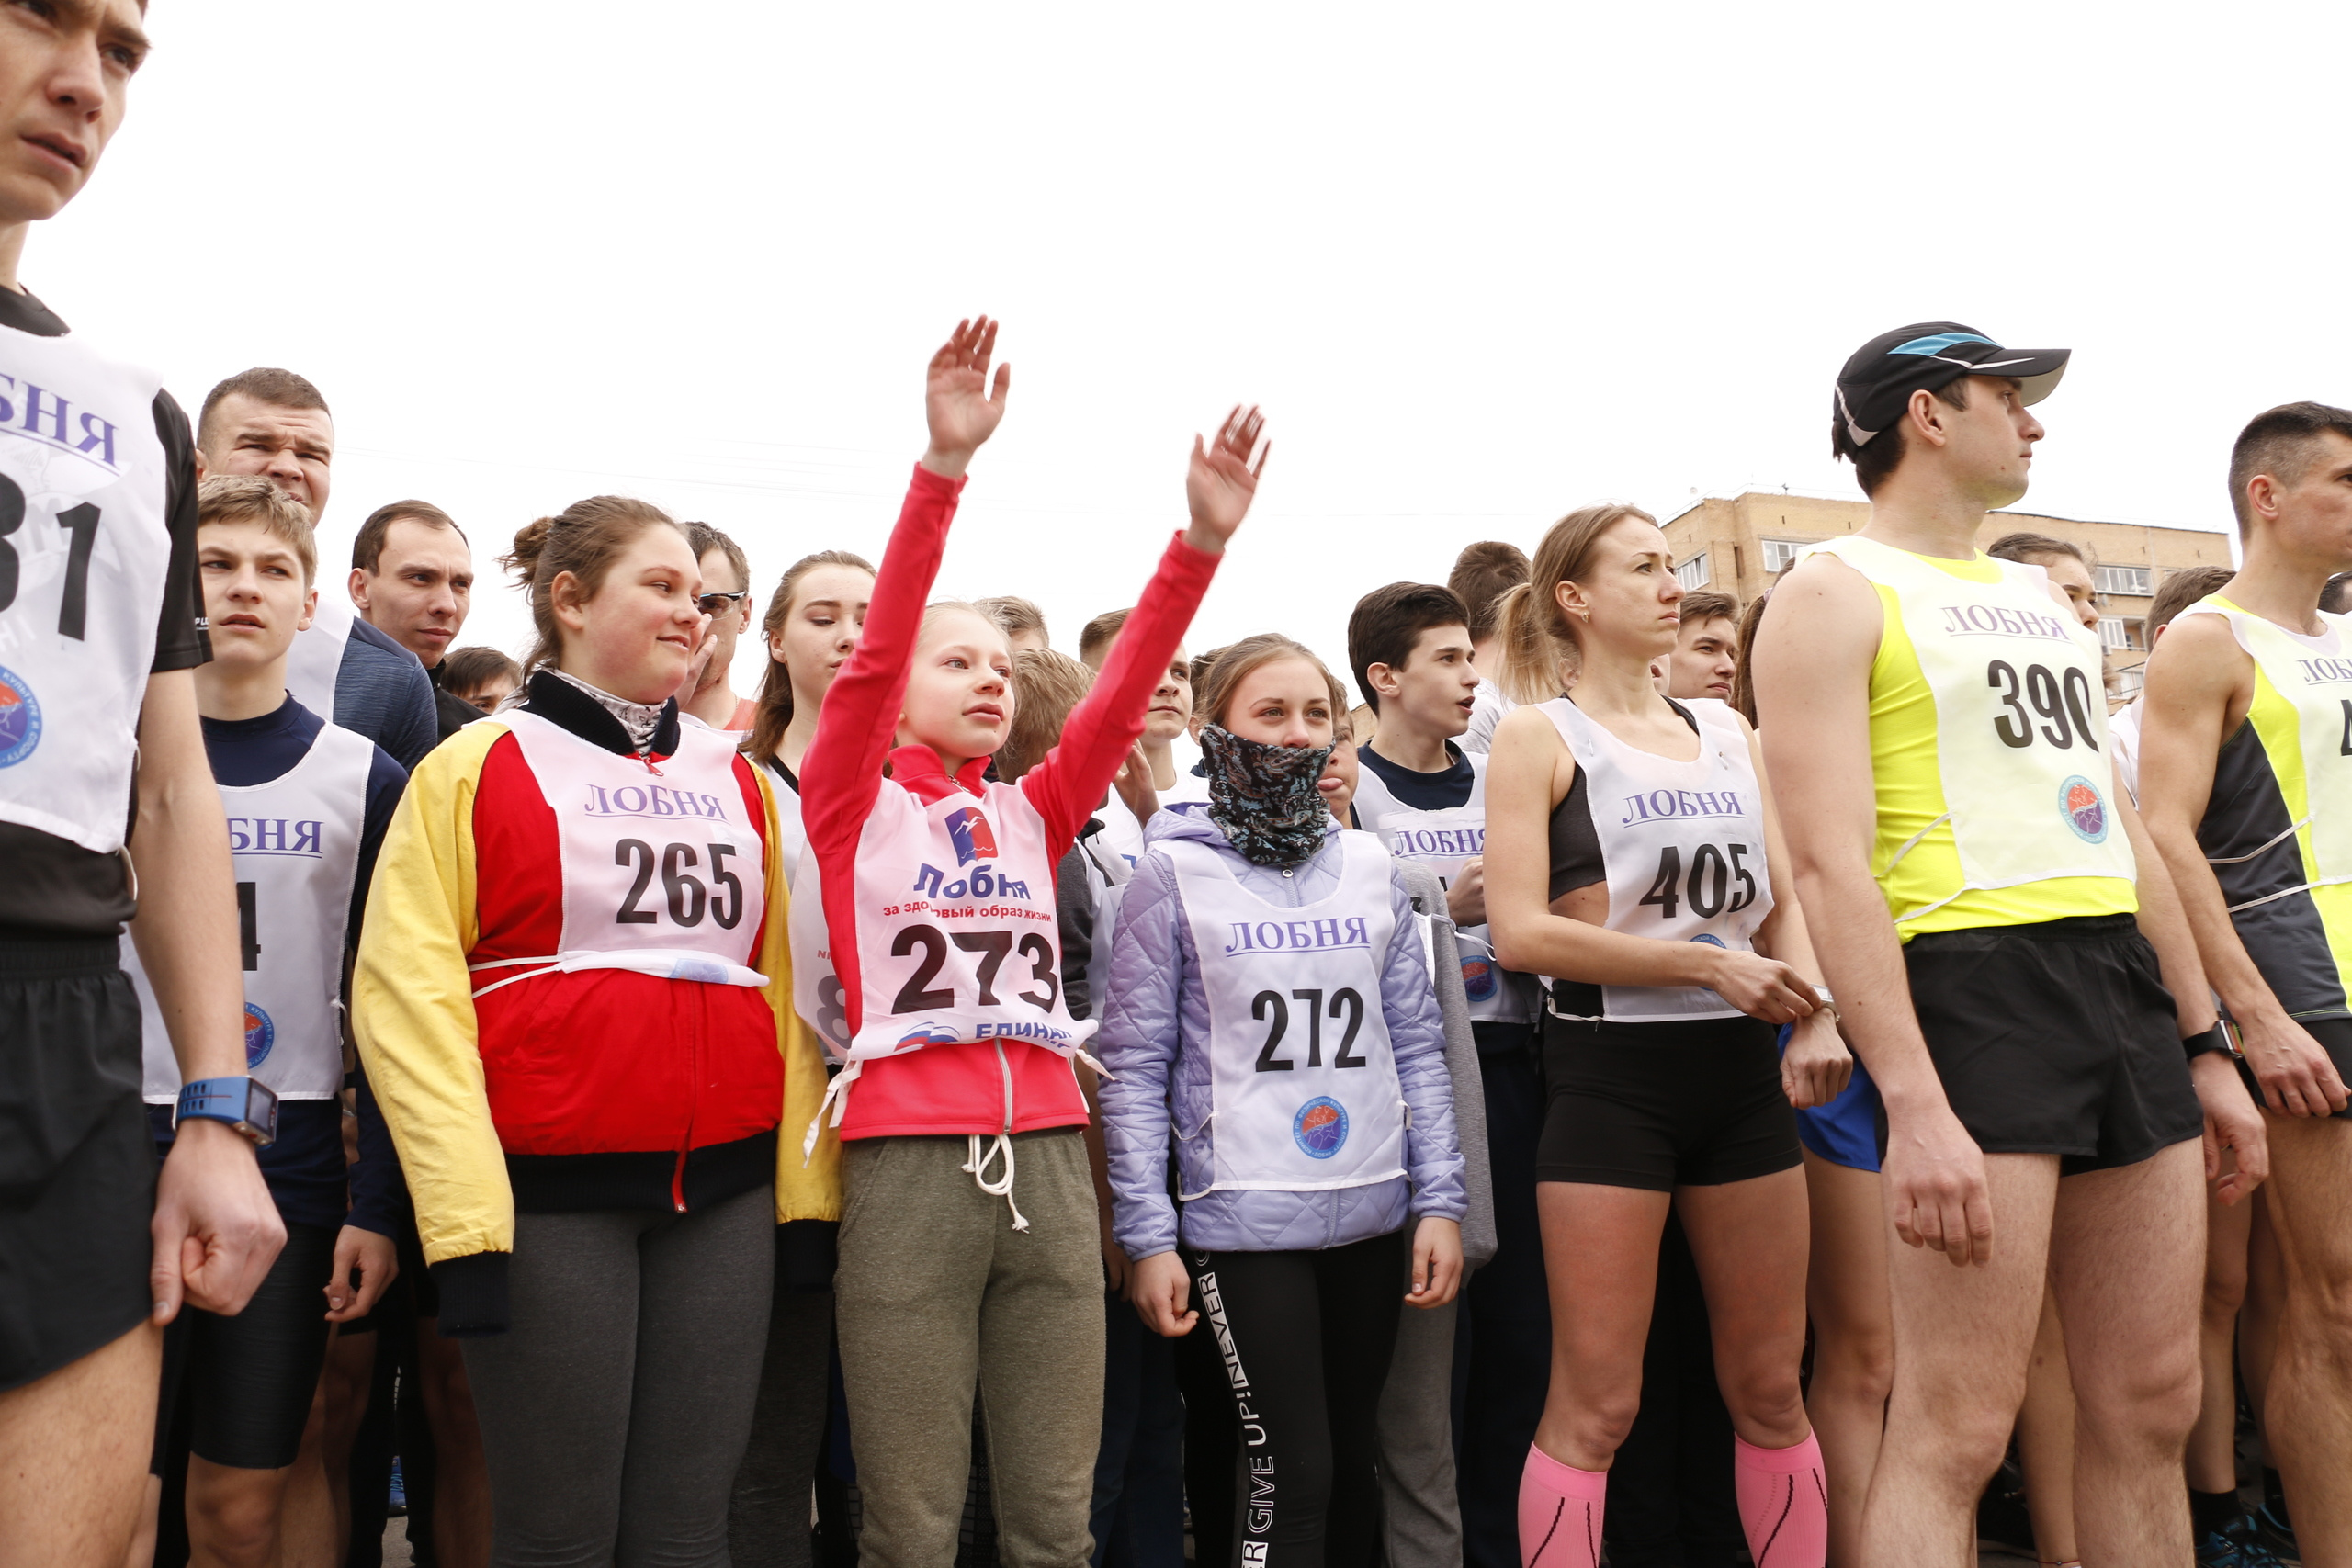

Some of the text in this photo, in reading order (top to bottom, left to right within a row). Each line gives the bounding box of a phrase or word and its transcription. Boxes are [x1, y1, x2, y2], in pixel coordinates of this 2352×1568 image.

[1939, 604, 2071, 640] ЛОБНЯ
[1987, 660, 2099, 753] 390
[584, 784, 727, 820] ЛОБНЯ
[1622, 789, 1746, 824] ЛОБНЯ
[227, 818, 325, 854] БНЯ
[615, 838, 743, 930] 265
[883, 901, 1052, 923] за здоовый образ жизни
[1639, 843, 1756, 919] 405
[1226, 918, 1371, 953] ЛОБНЯ
[890, 924, 1058, 1015] 273
[1251, 987, 1366, 1073] 272
[1200, 1273, 1246, 1385] NEVER
[1236, 1391, 1267, 1446] UP!
[1247, 1456, 1275, 1534] GIVE
